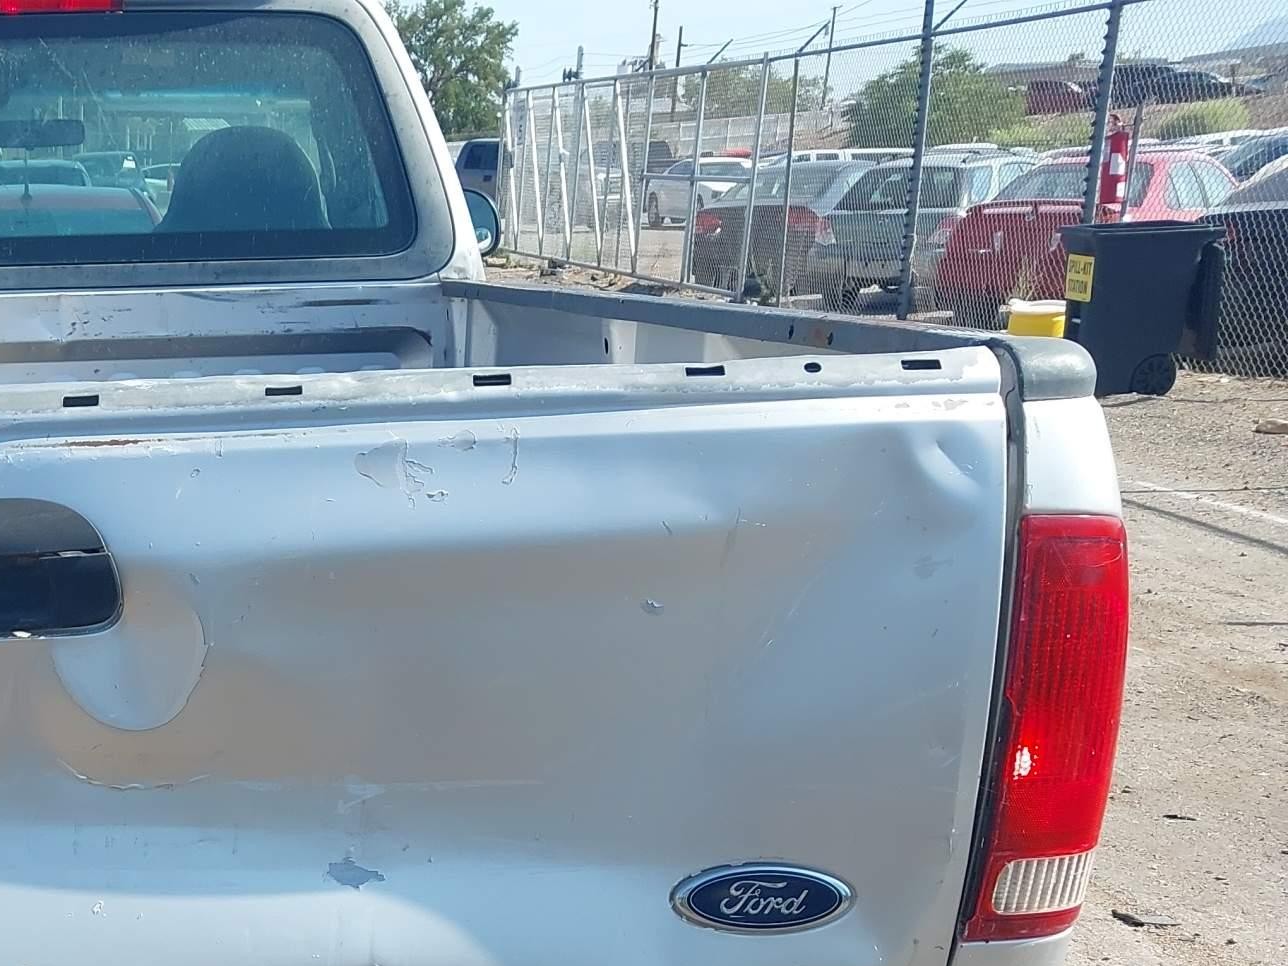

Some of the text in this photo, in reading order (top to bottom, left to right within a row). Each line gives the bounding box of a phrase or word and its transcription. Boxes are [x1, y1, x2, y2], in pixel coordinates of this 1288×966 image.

[1069, 260, 1093, 276] SPILL-KIT
[1067, 278, 1089, 295] STATION
[720, 880, 809, 915] Ford
